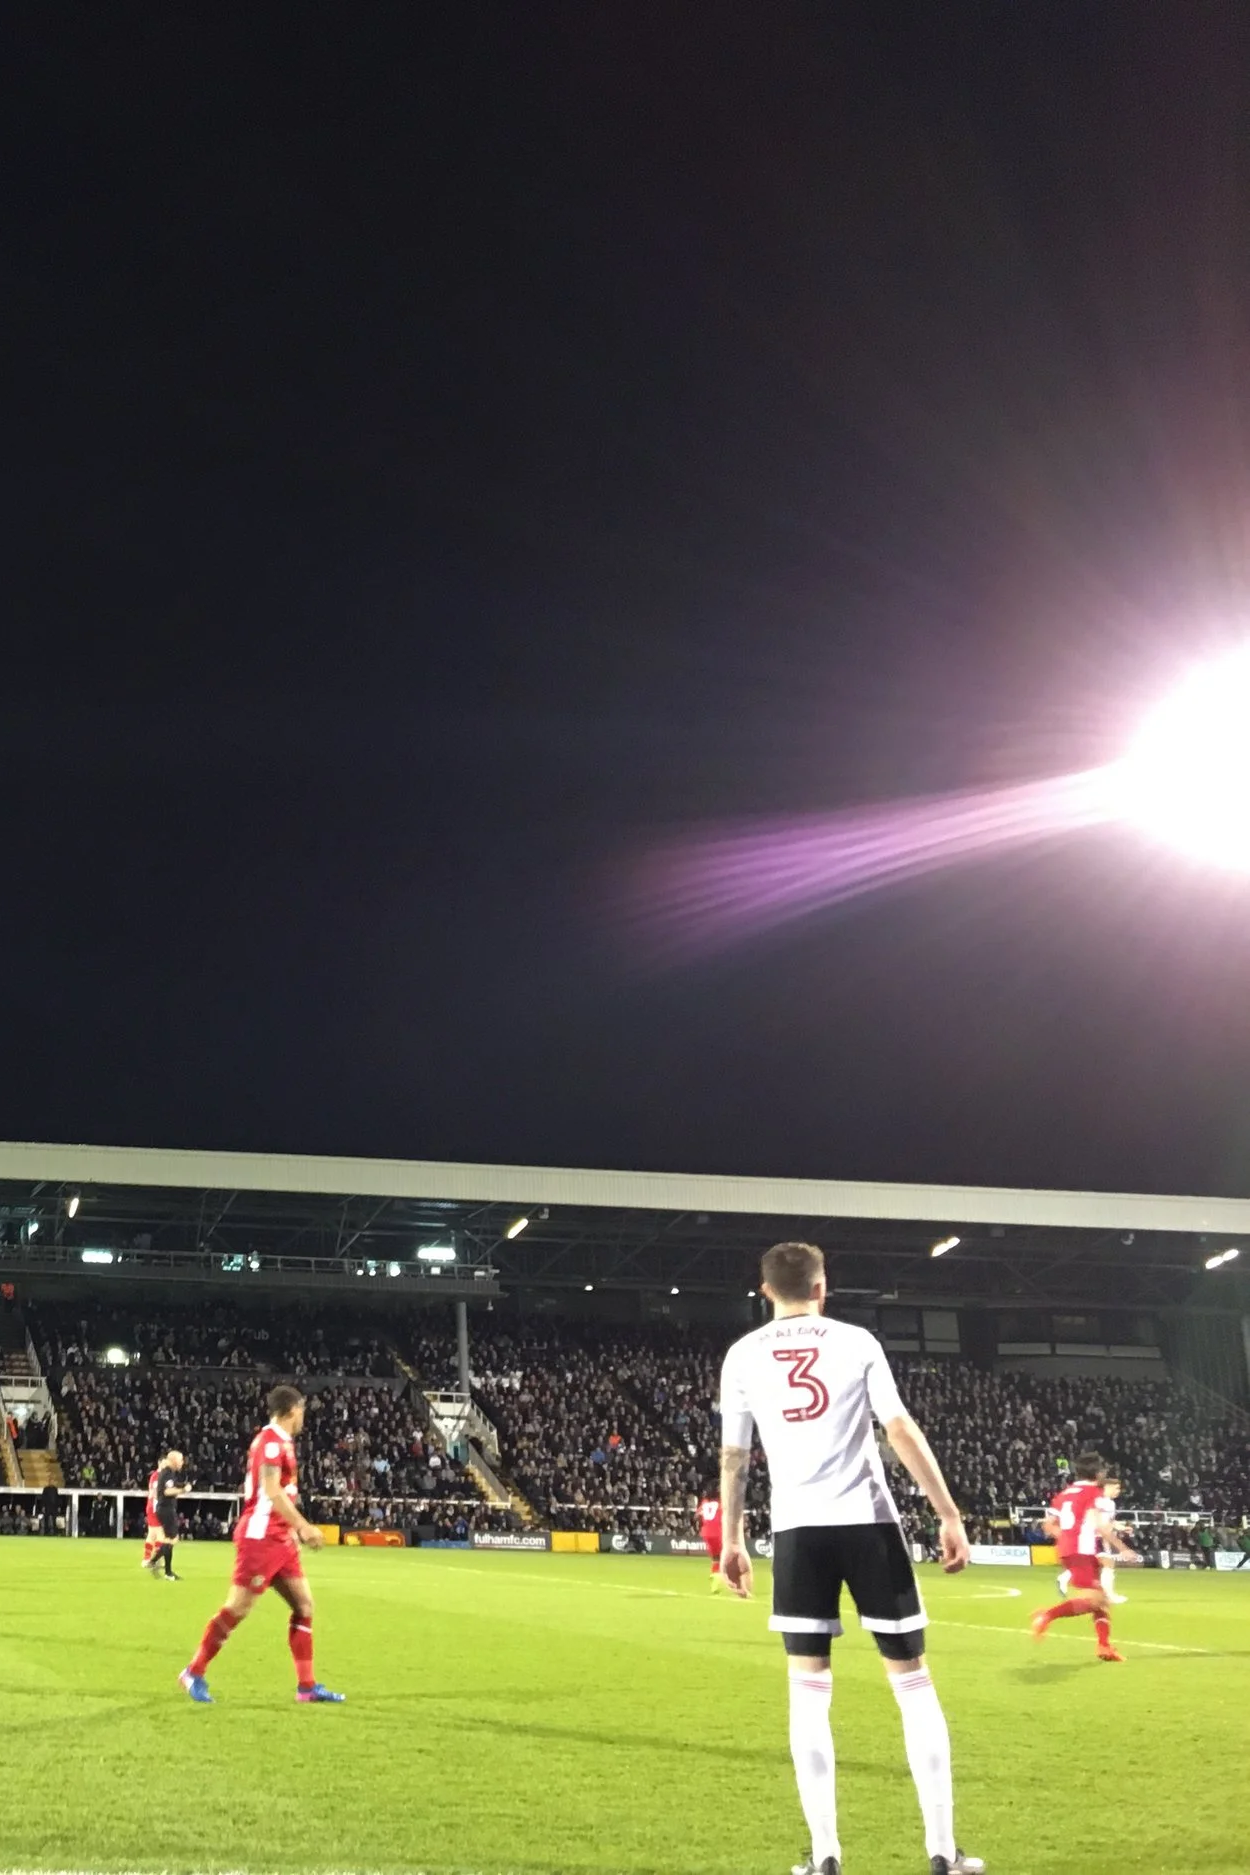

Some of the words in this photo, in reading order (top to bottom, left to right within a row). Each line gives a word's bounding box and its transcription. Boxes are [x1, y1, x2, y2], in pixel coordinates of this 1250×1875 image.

[772, 1347, 830, 1422] 3
[473, 1533, 546, 1546] fulhamfc.com
[990, 1548, 1028, 1557] FLORIDA
